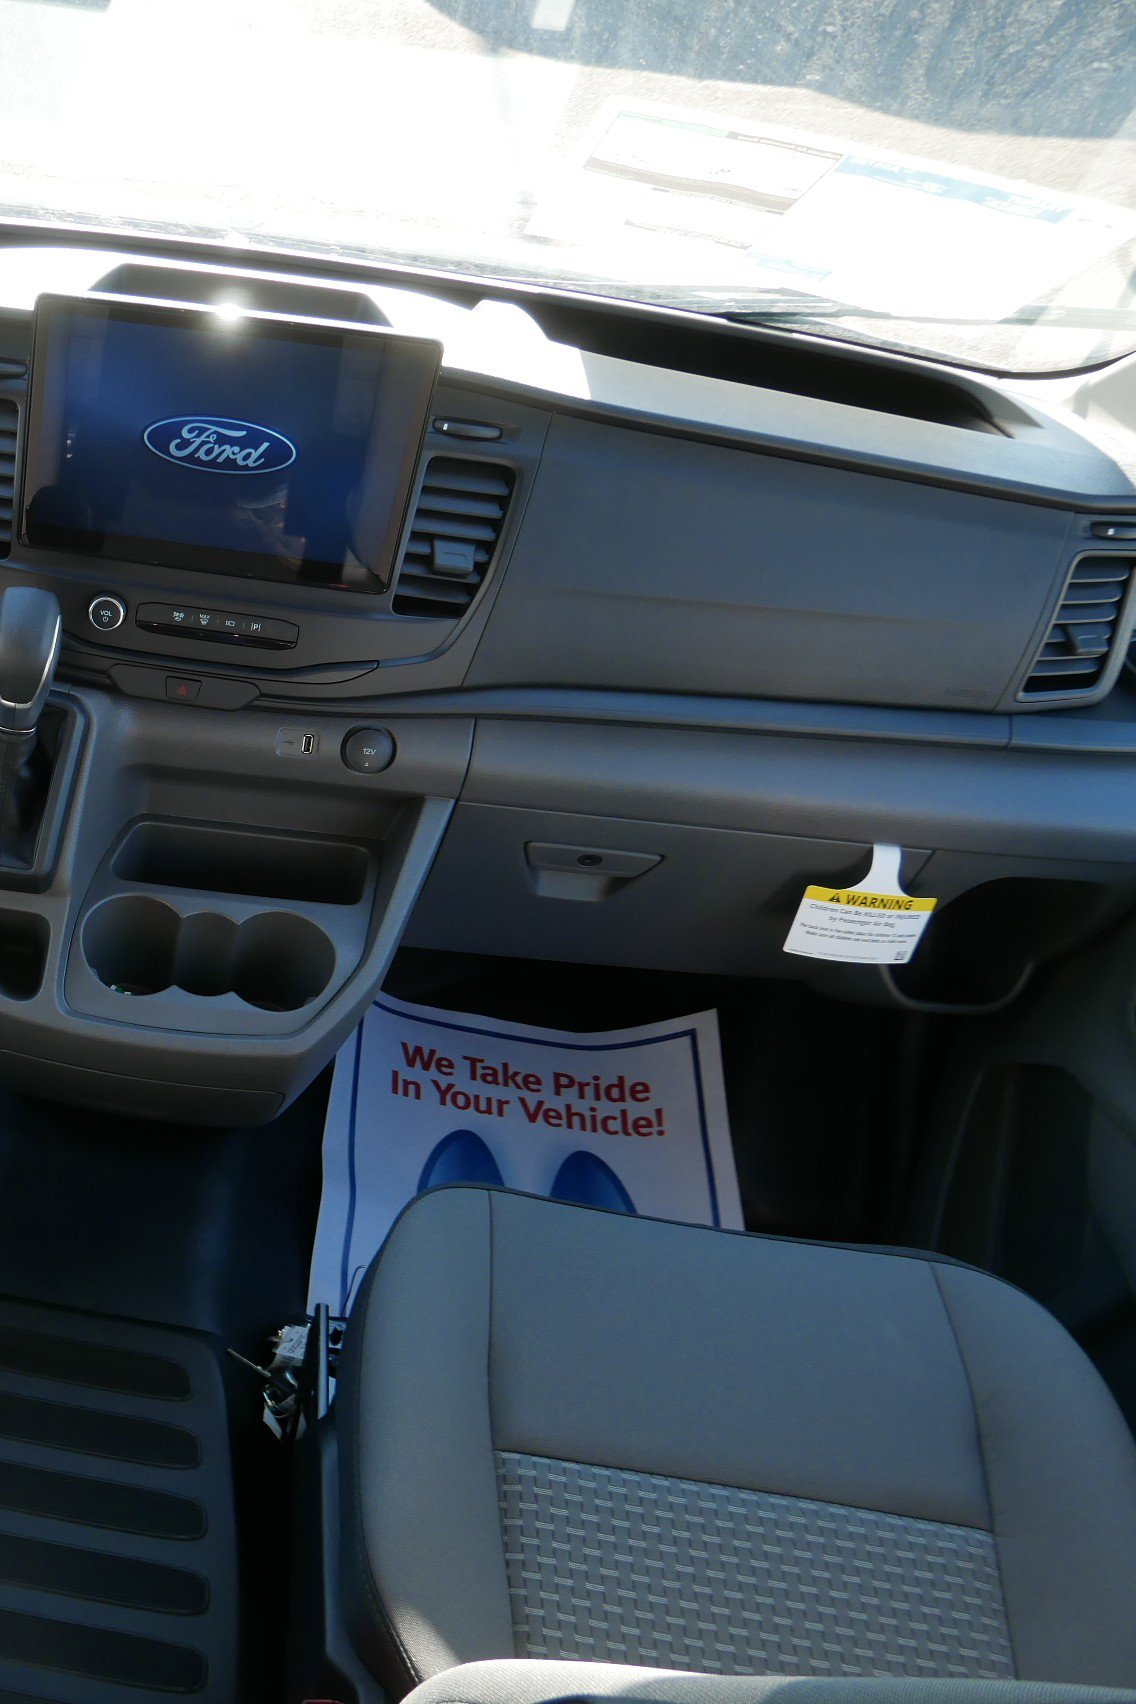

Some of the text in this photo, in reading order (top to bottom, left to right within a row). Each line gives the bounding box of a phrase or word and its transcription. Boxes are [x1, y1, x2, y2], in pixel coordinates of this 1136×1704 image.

[169, 423, 270, 467] Ford
[362, 747, 377, 756] 12V
[809, 903, 839, 913] Children
[846, 894, 913, 910] WARNING
[400, 1041, 651, 1103] We Take Pride
[391, 1069, 666, 1138] In Your Vehicle!
